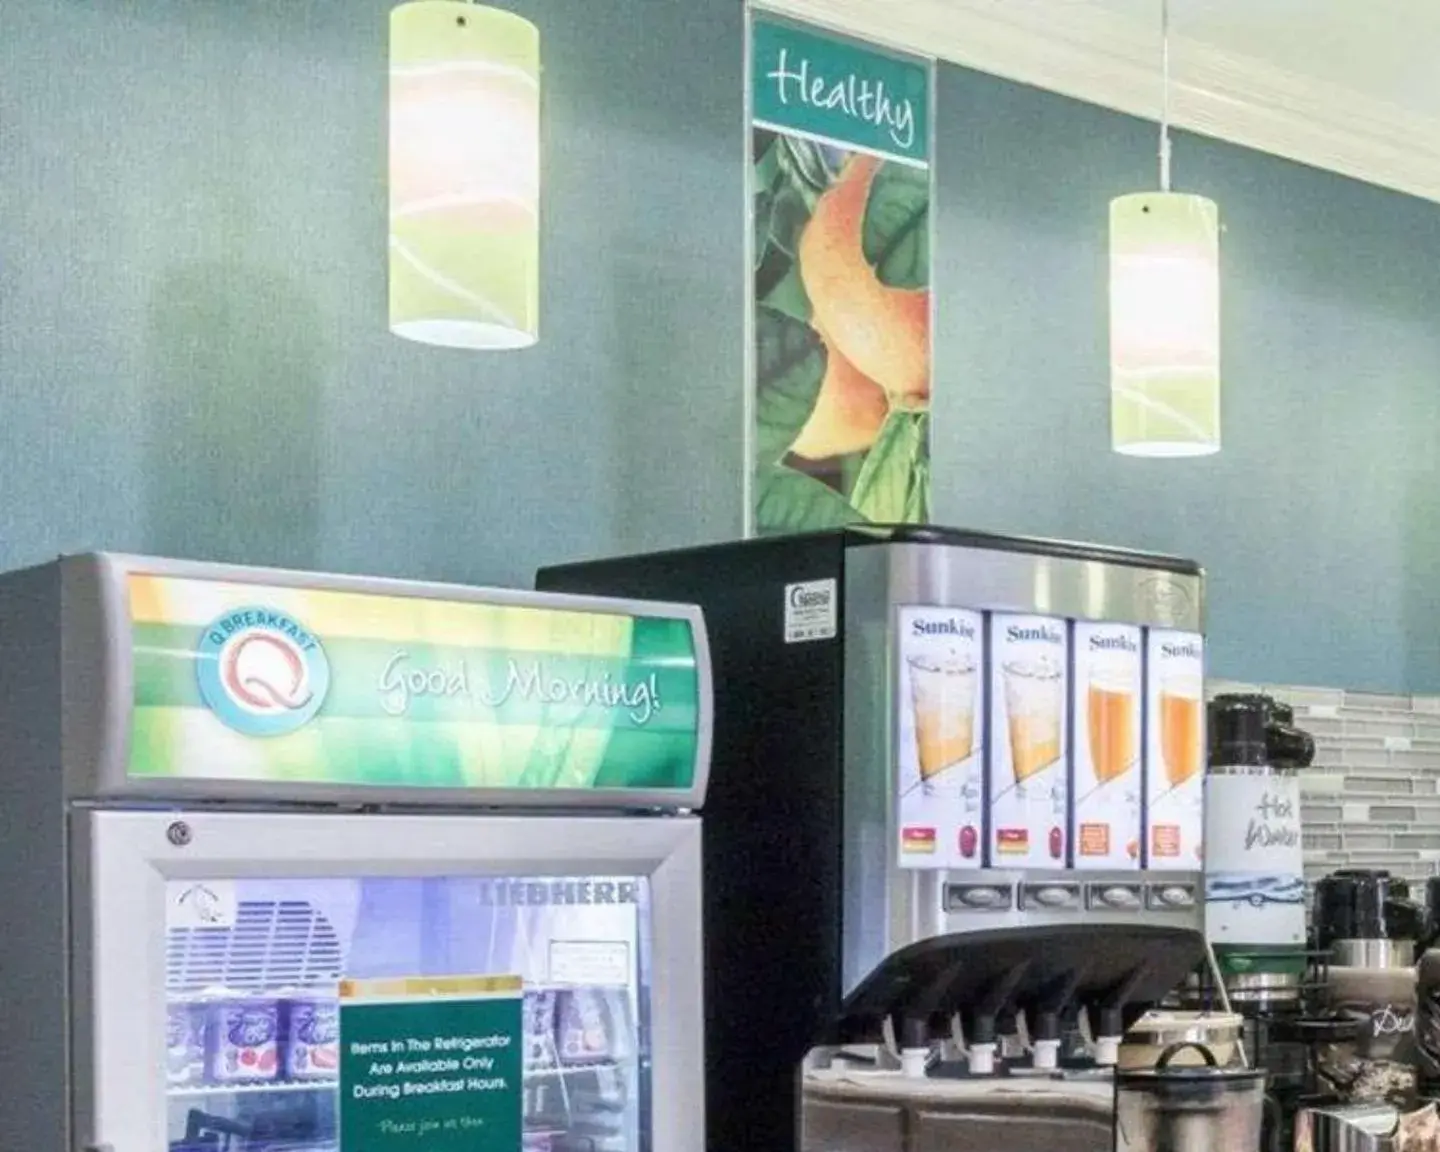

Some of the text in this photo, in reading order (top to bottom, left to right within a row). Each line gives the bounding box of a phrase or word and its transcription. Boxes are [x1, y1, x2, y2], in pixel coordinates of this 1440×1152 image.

[766, 48, 915, 149] Healthy
[209, 610, 317, 652] Q BREAKFAST
[225, 632, 315, 711] Q
[377, 650, 663, 726] Good Morning!
[1255, 790, 1294, 820] Hot
[478, 880, 640, 906] LIEBHERR
[350, 1035, 512, 1054] Items In The Refrigerator
[369, 1056, 494, 1075] Are Available Only
[353, 1083, 401, 1098] During
[403, 1079, 466, 1095] Breakfast
